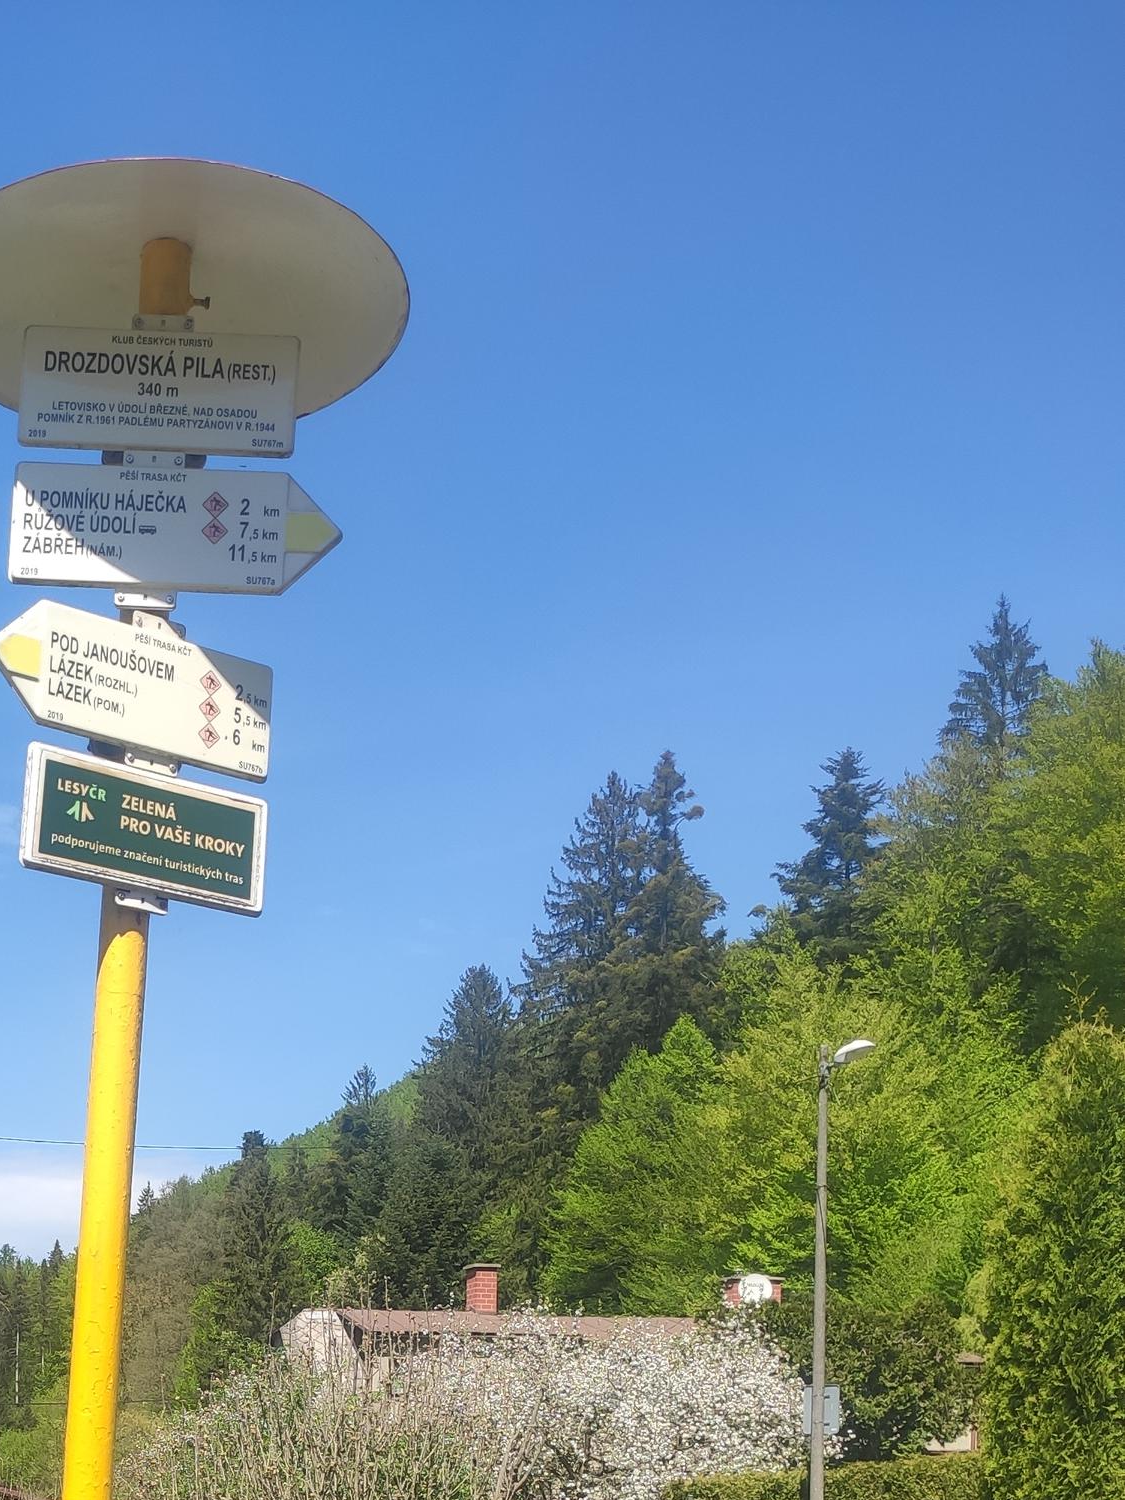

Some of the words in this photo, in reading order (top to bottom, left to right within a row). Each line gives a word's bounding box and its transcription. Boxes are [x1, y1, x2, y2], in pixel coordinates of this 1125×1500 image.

[112, 336, 134, 345] KLUB
[136, 335, 176, 346] ČESKÝCH
[178, 337, 214, 348] TURISTŮ
[44, 350, 177, 377] DROZDOVSKÁ
[183, 356, 225, 379] PILA
[228, 362, 276, 385] (REST.)
[137, 382, 162, 397] 340
[166, 387, 179, 397] m
[38, 412, 75, 424] POMNÍK
[77, 414, 84, 424] Z
[118, 414, 164, 427] PADLÉMU
[167, 418, 234, 430] PARTYZÁNOVI
[236, 421, 242, 431] V
[52, 401, 106, 413] LETOVISKO
[109, 403, 116, 413] V
[118, 401, 148, 414] ÚDOLÍ
[193, 407, 214, 417] NAD
[216, 408, 258, 419] OSADOU
[28, 429, 47, 438] 2019
[252, 438, 284, 448] SU767m
[120, 472, 139, 482] PĚŠÍ
[141, 472, 168, 482] TRASA
[170, 472, 187, 483] KČT
[25, 490, 37, 507] U
[39, 488, 110, 512] POMNÍKU
[114, 490, 187, 514] HÁJEČKA
[240, 498, 250, 516] 2
[264, 506, 280, 517] km
[23, 508, 85, 532] RŮŽOVÉ
[90, 512, 137, 535] ÚDOLÍ
[239, 522, 259, 541] 7,5
[262, 528, 278, 540] km
[22, 534, 84, 554] ZÁBŘEH
[86, 543, 122, 560] (NÁM.)
[228, 544, 258, 564] 11,5
[260, 552, 277, 564] km
[20, 568, 39, 576] 2019
[246, 576, 276, 586] SU767a
[135, 632, 151, 646] PĚŠÍ
[152, 638, 176, 652] TRASA
[177, 644, 192, 656] KČT
[51, 632, 79, 655] POD
[82, 641, 174, 682] JANOUŠOVEM
[235, 684, 252, 705] 2,5
[254, 696, 268, 708] km
[49, 656, 93, 684] LÁZEK
[94, 672, 138, 698] (ROZHL.)
[234, 707, 251, 728] 5,5
[254, 717, 266, 730] km
[48, 677, 92, 706] LÁZEK
[93, 696, 126, 718] (POM.)
[233, 728, 240, 746] 6
[252, 740, 265, 753] km
[48, 710, 64, 722] 2019
[121, 794, 176, 821] ZELENÁ
[120, 815, 151, 836] PRO
[154, 822, 192, 846] VAŠE
[194, 833, 246, 858] KROKY
[51, 832, 122, 858] podporujeme
[123, 848, 164, 866] značení
[165, 857, 223, 880] turistických
[224, 871, 244, 885] tras
